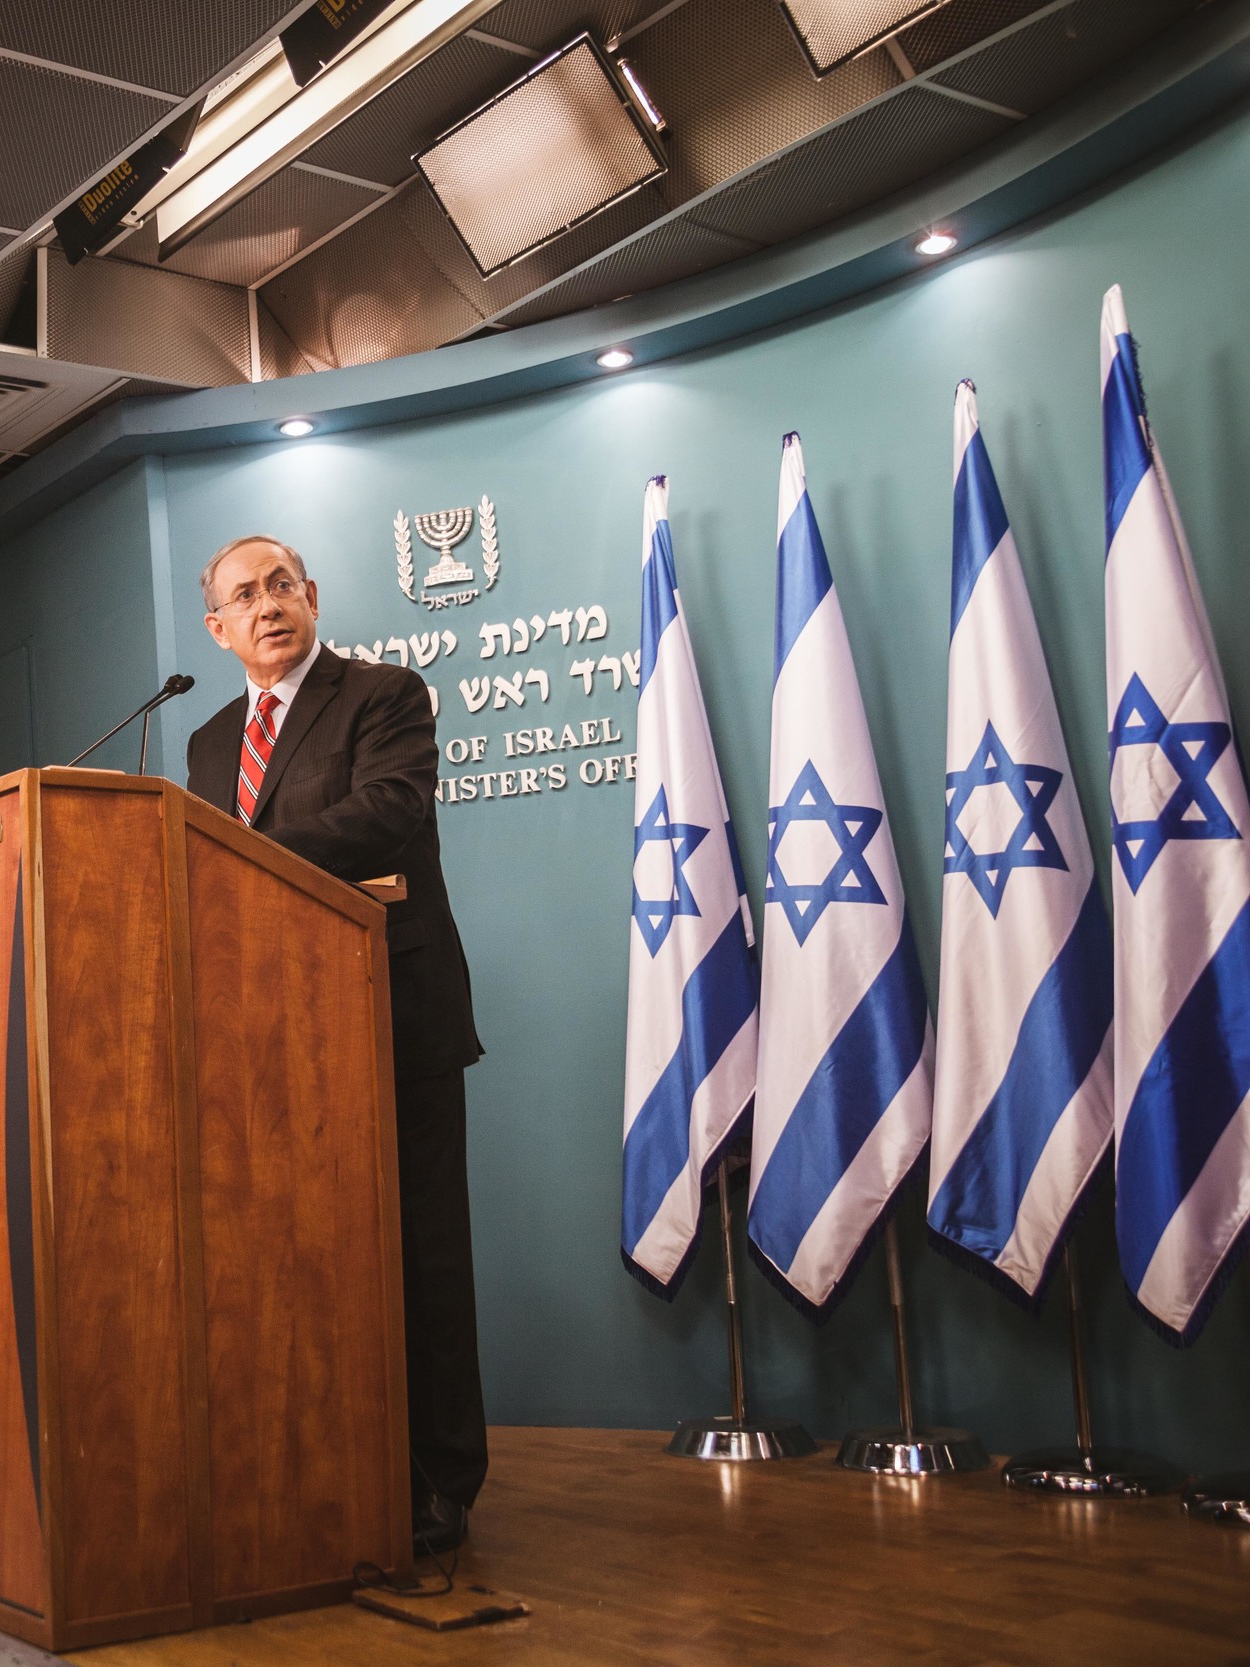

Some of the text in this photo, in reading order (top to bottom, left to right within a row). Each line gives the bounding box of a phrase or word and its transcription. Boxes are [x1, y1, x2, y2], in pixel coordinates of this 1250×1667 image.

[82, 159, 132, 213] Duolite
[421, 588, 479, 610] ישראל
[478, 604, 607, 658] מדינת
[458, 667, 549, 713] ראש
[445, 717, 621, 763] OF ISRAEL
